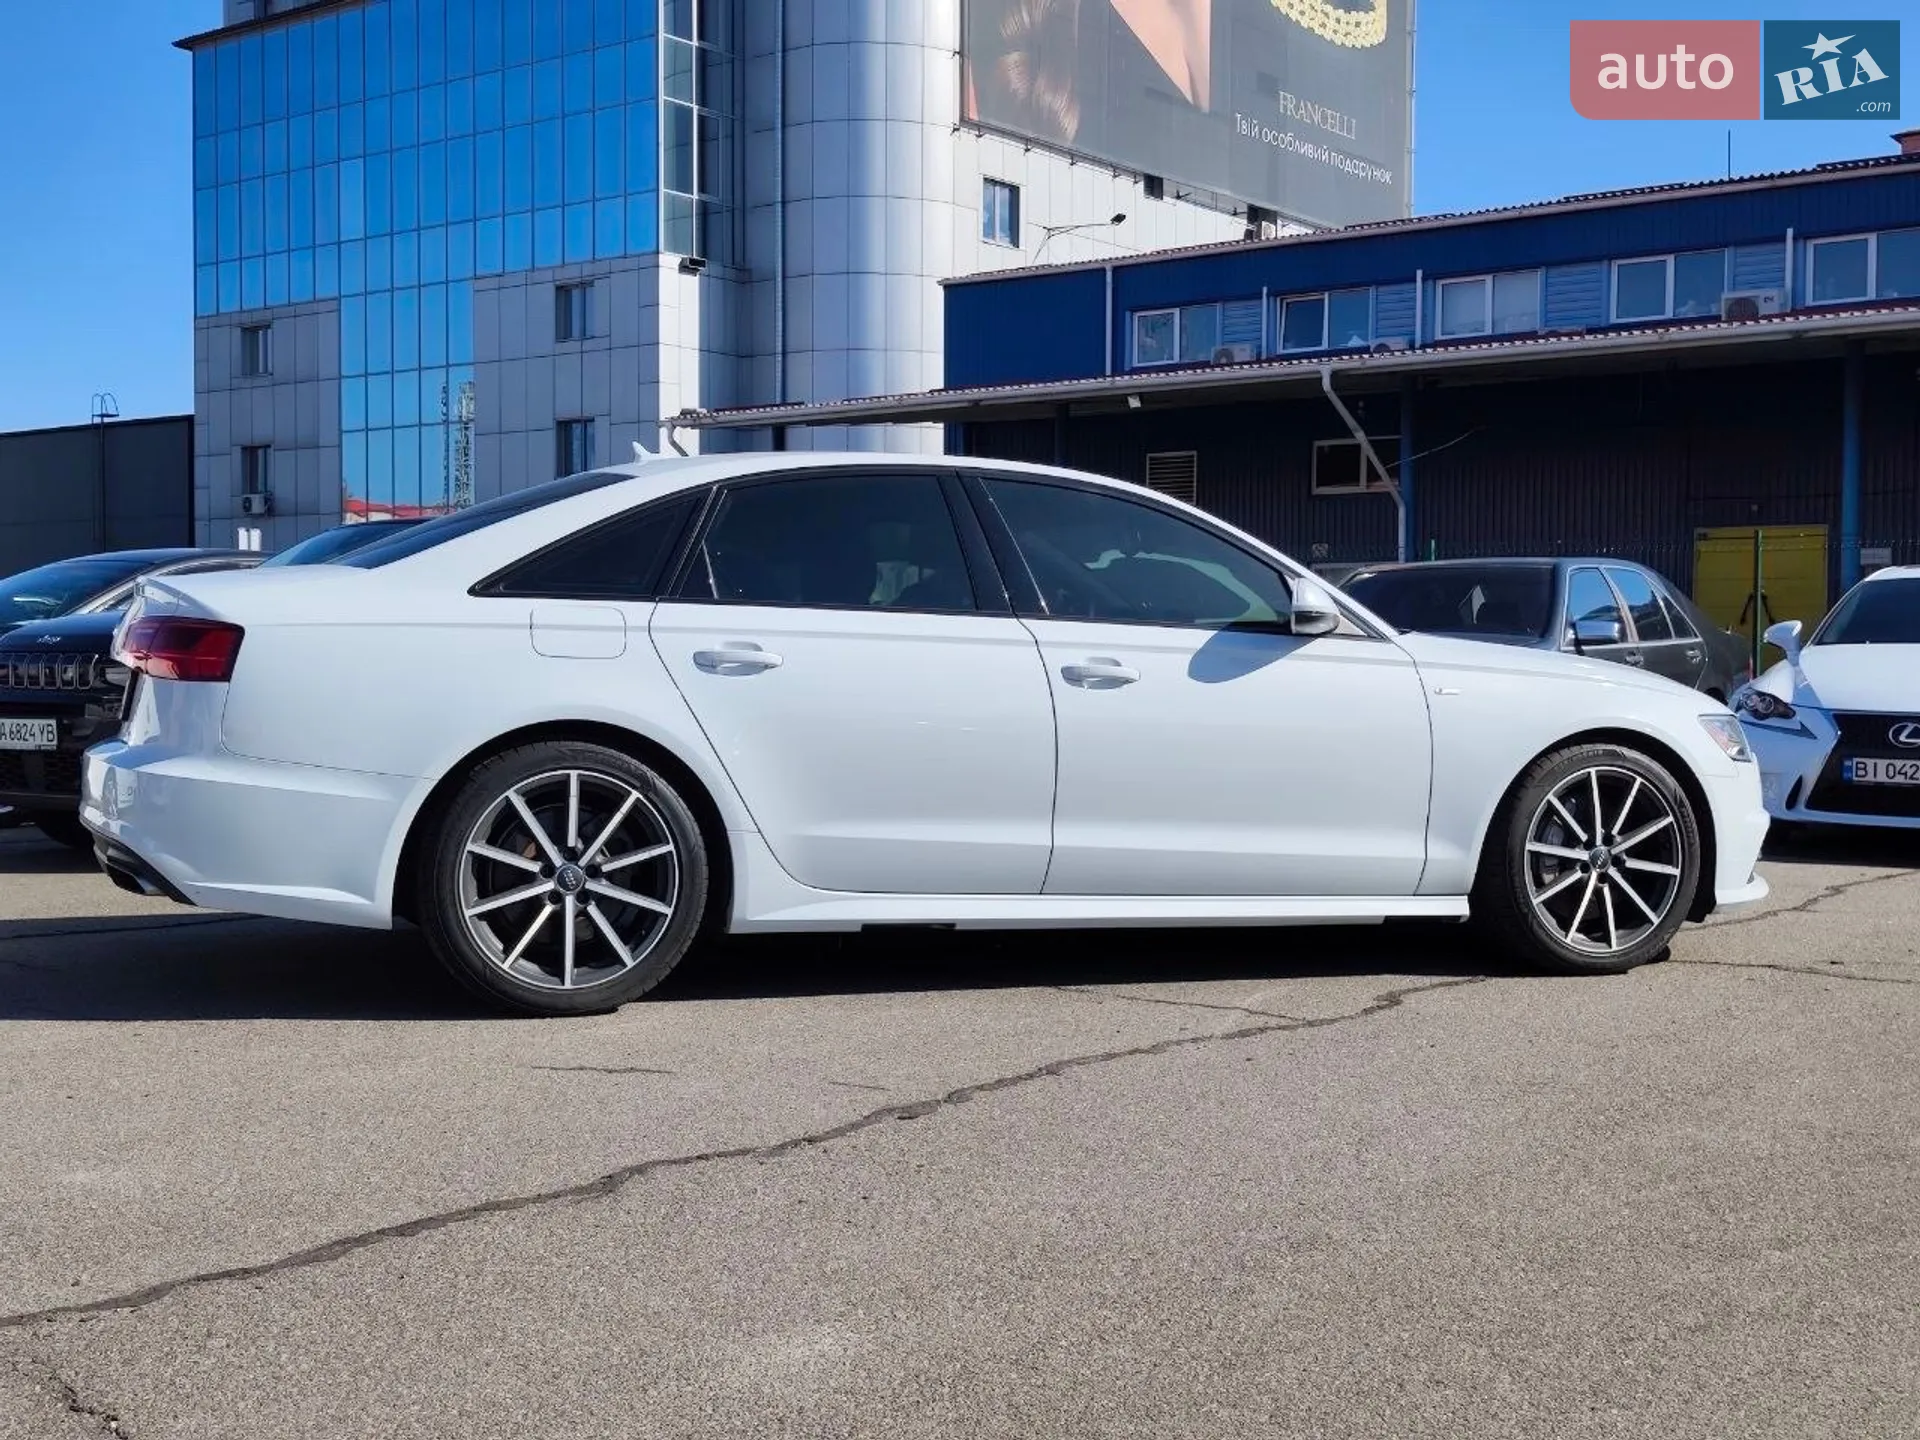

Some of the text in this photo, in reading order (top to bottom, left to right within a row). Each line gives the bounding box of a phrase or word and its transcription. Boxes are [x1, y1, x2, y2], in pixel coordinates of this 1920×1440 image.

[1278, 90, 1357, 140] FRANCELLI
[1235, 112, 1392, 186] Твій особливий подарунок
[1855, 761, 1878, 779] BI
[1885, 762, 1920, 781] 042
